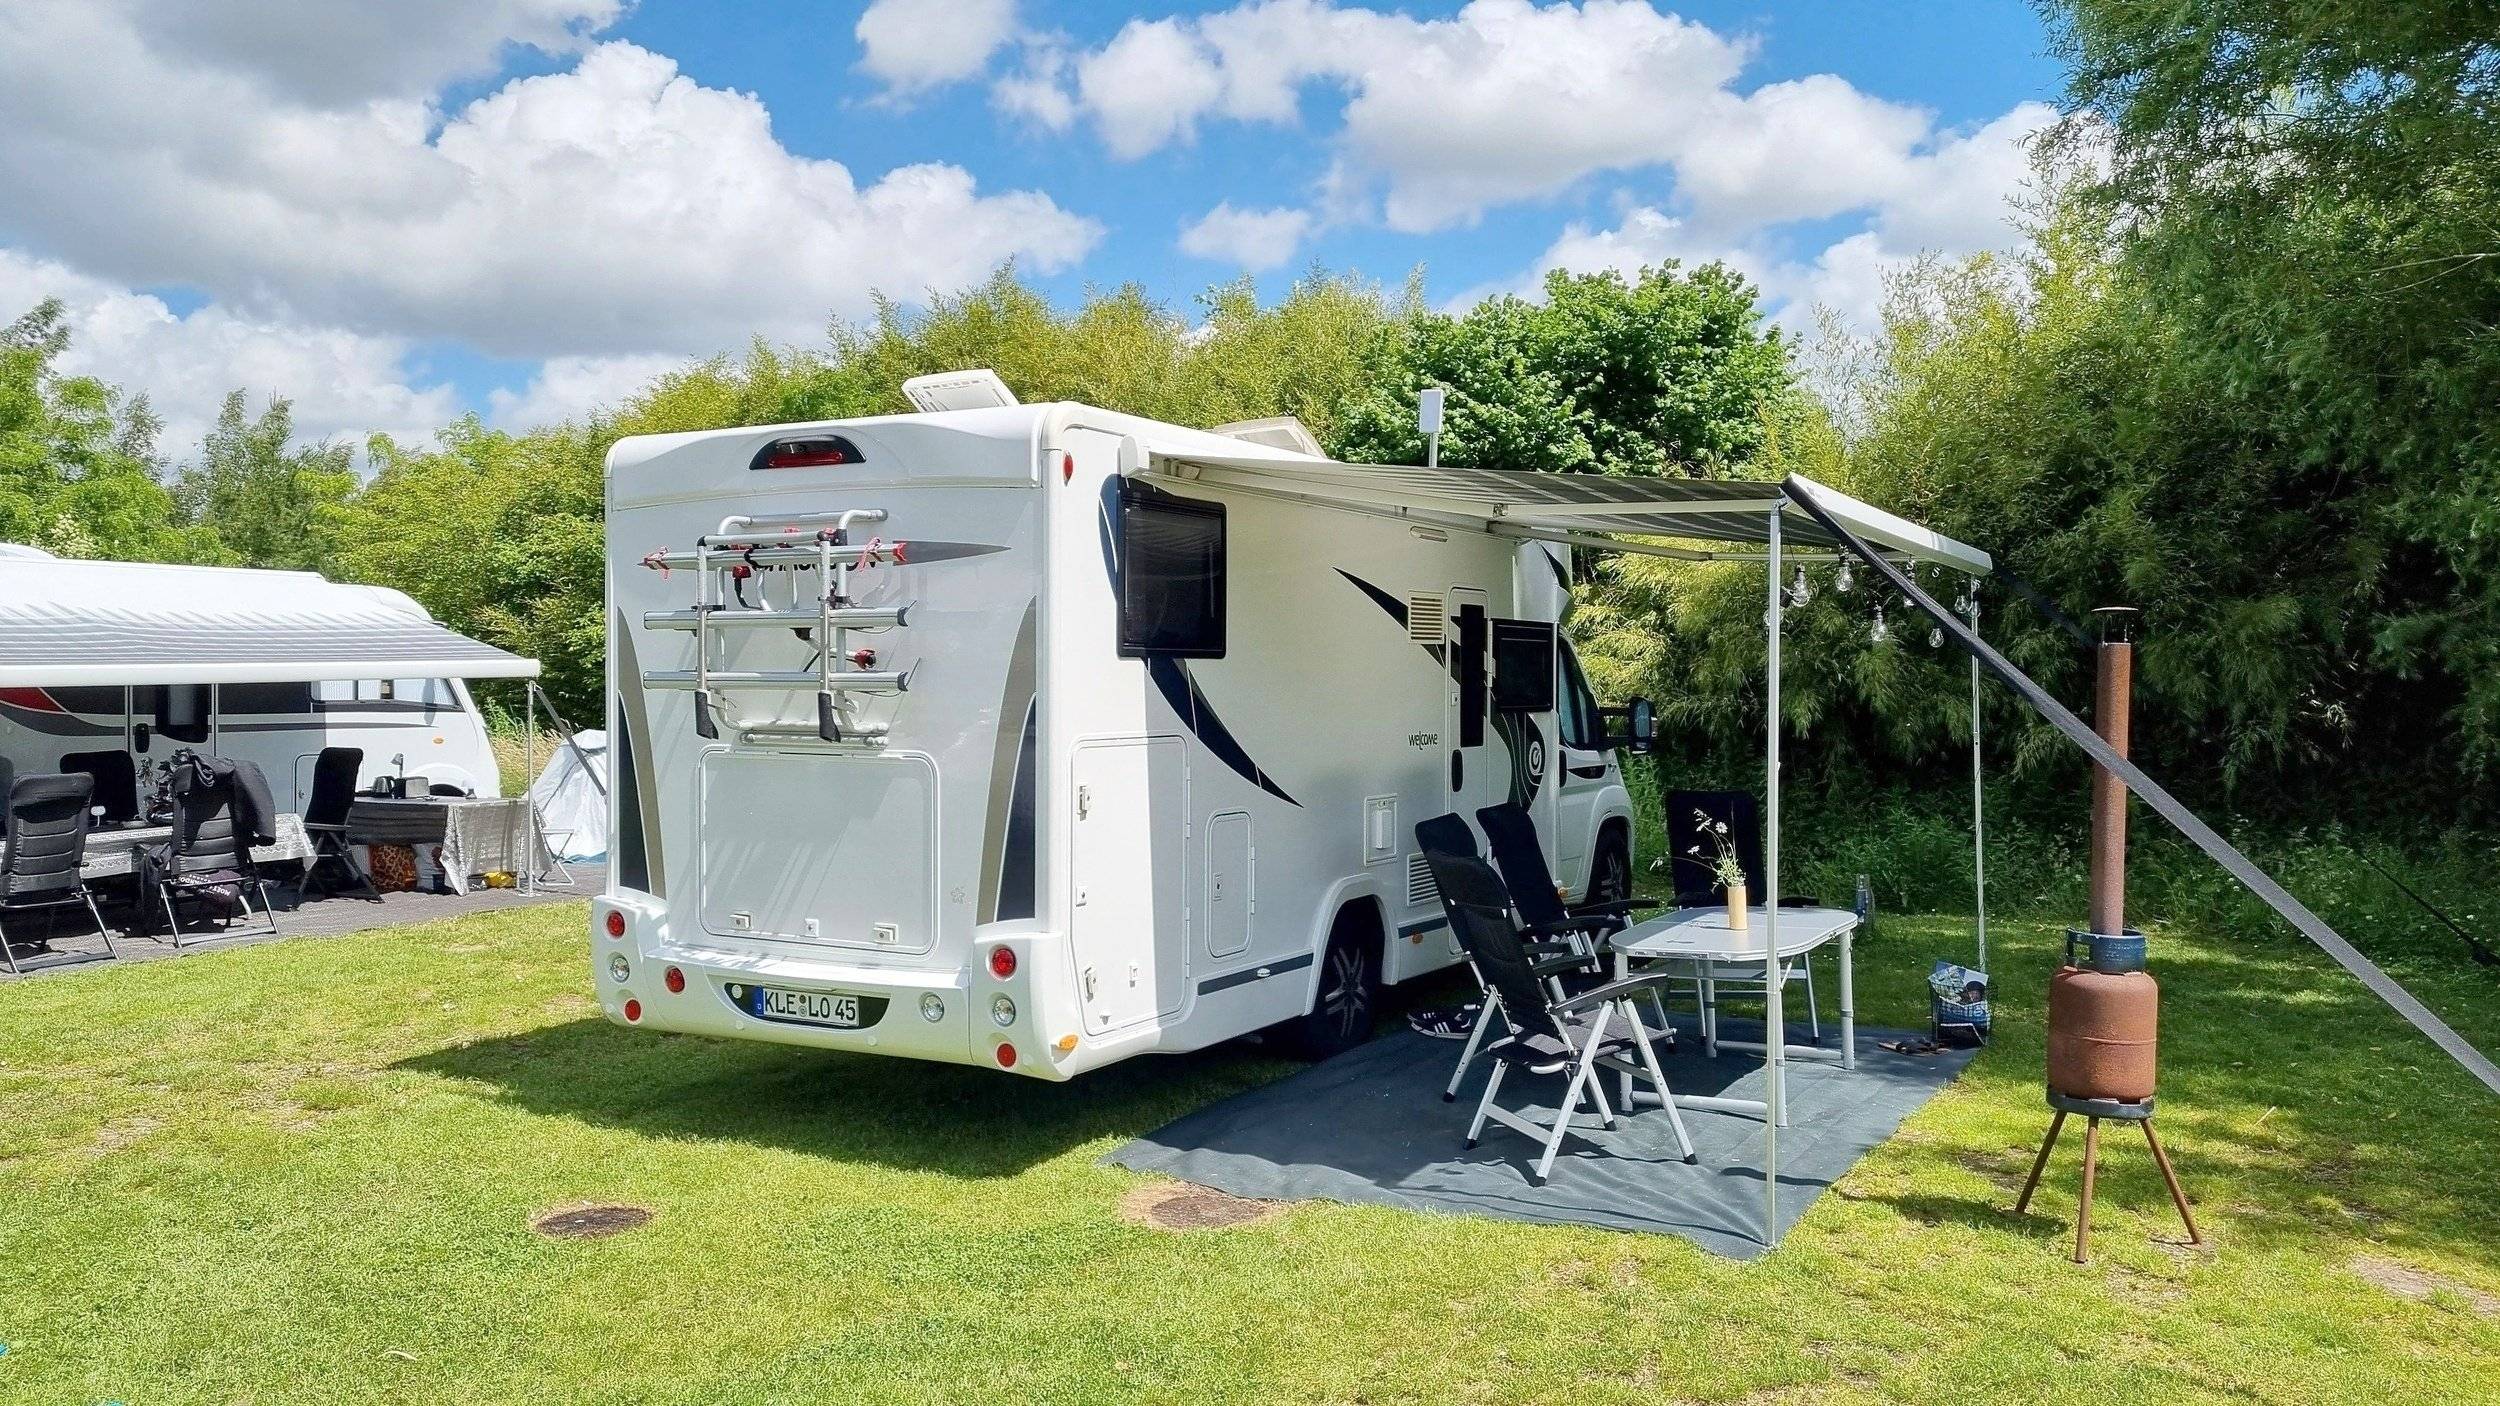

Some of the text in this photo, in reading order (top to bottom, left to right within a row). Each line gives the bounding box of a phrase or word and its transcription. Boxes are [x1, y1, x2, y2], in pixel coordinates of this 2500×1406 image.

[1408, 731, 1438, 750] welcome
[765, 991, 856, 1021] KLE LO 45
